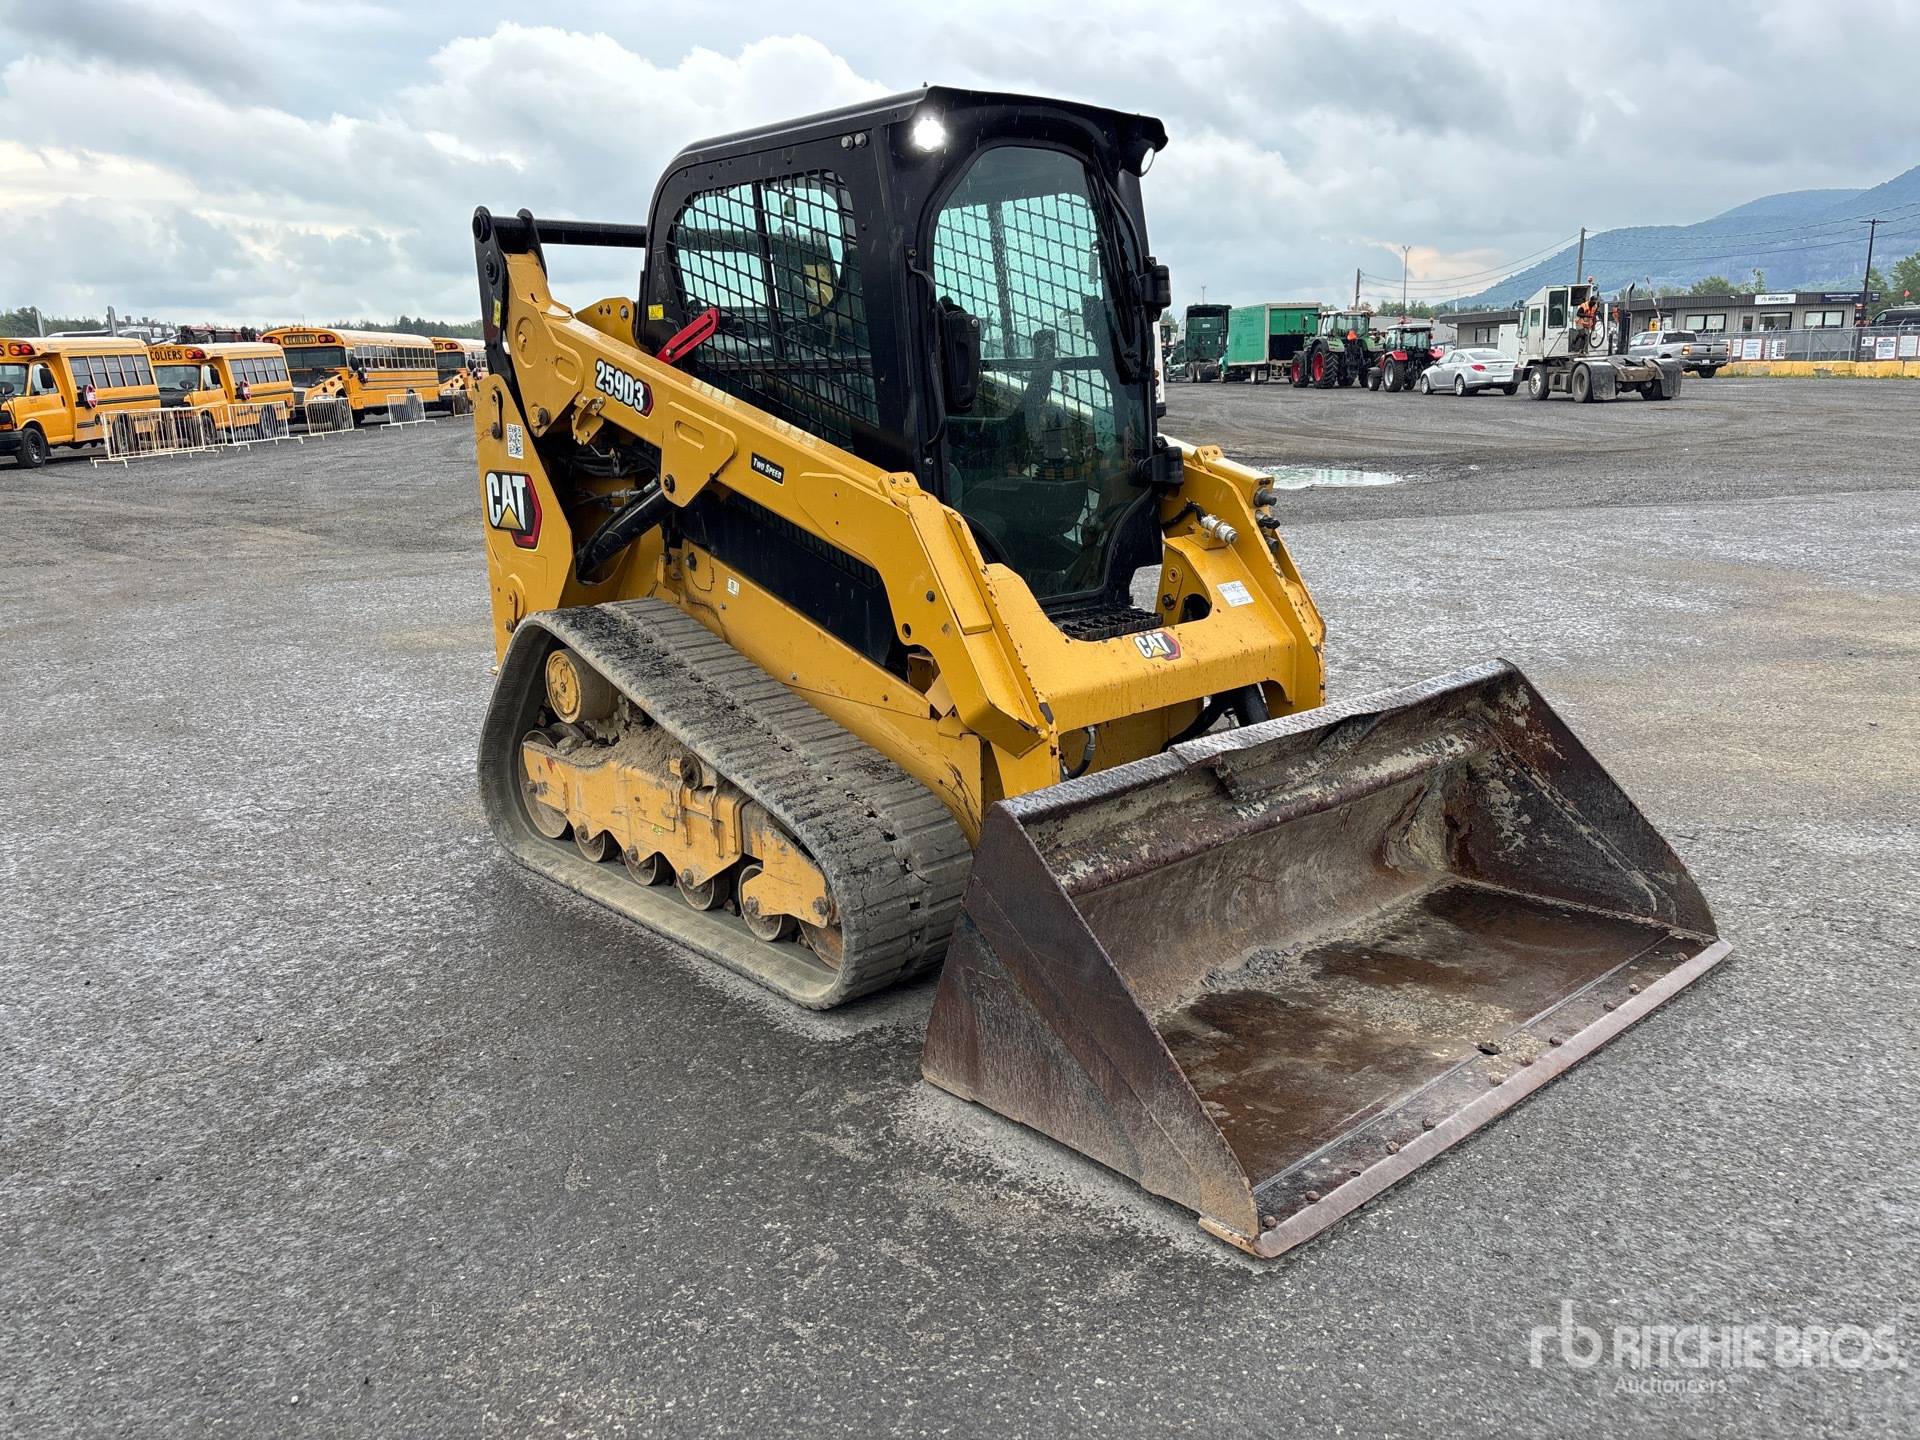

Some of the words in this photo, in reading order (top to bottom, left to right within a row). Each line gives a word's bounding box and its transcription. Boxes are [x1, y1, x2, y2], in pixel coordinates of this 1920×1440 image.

[150, 350, 183, 360] COLIERS
[595, 360, 645, 412] 259D3
[486, 472, 527, 531] CAT
[1134, 632, 1172, 658] CAT
